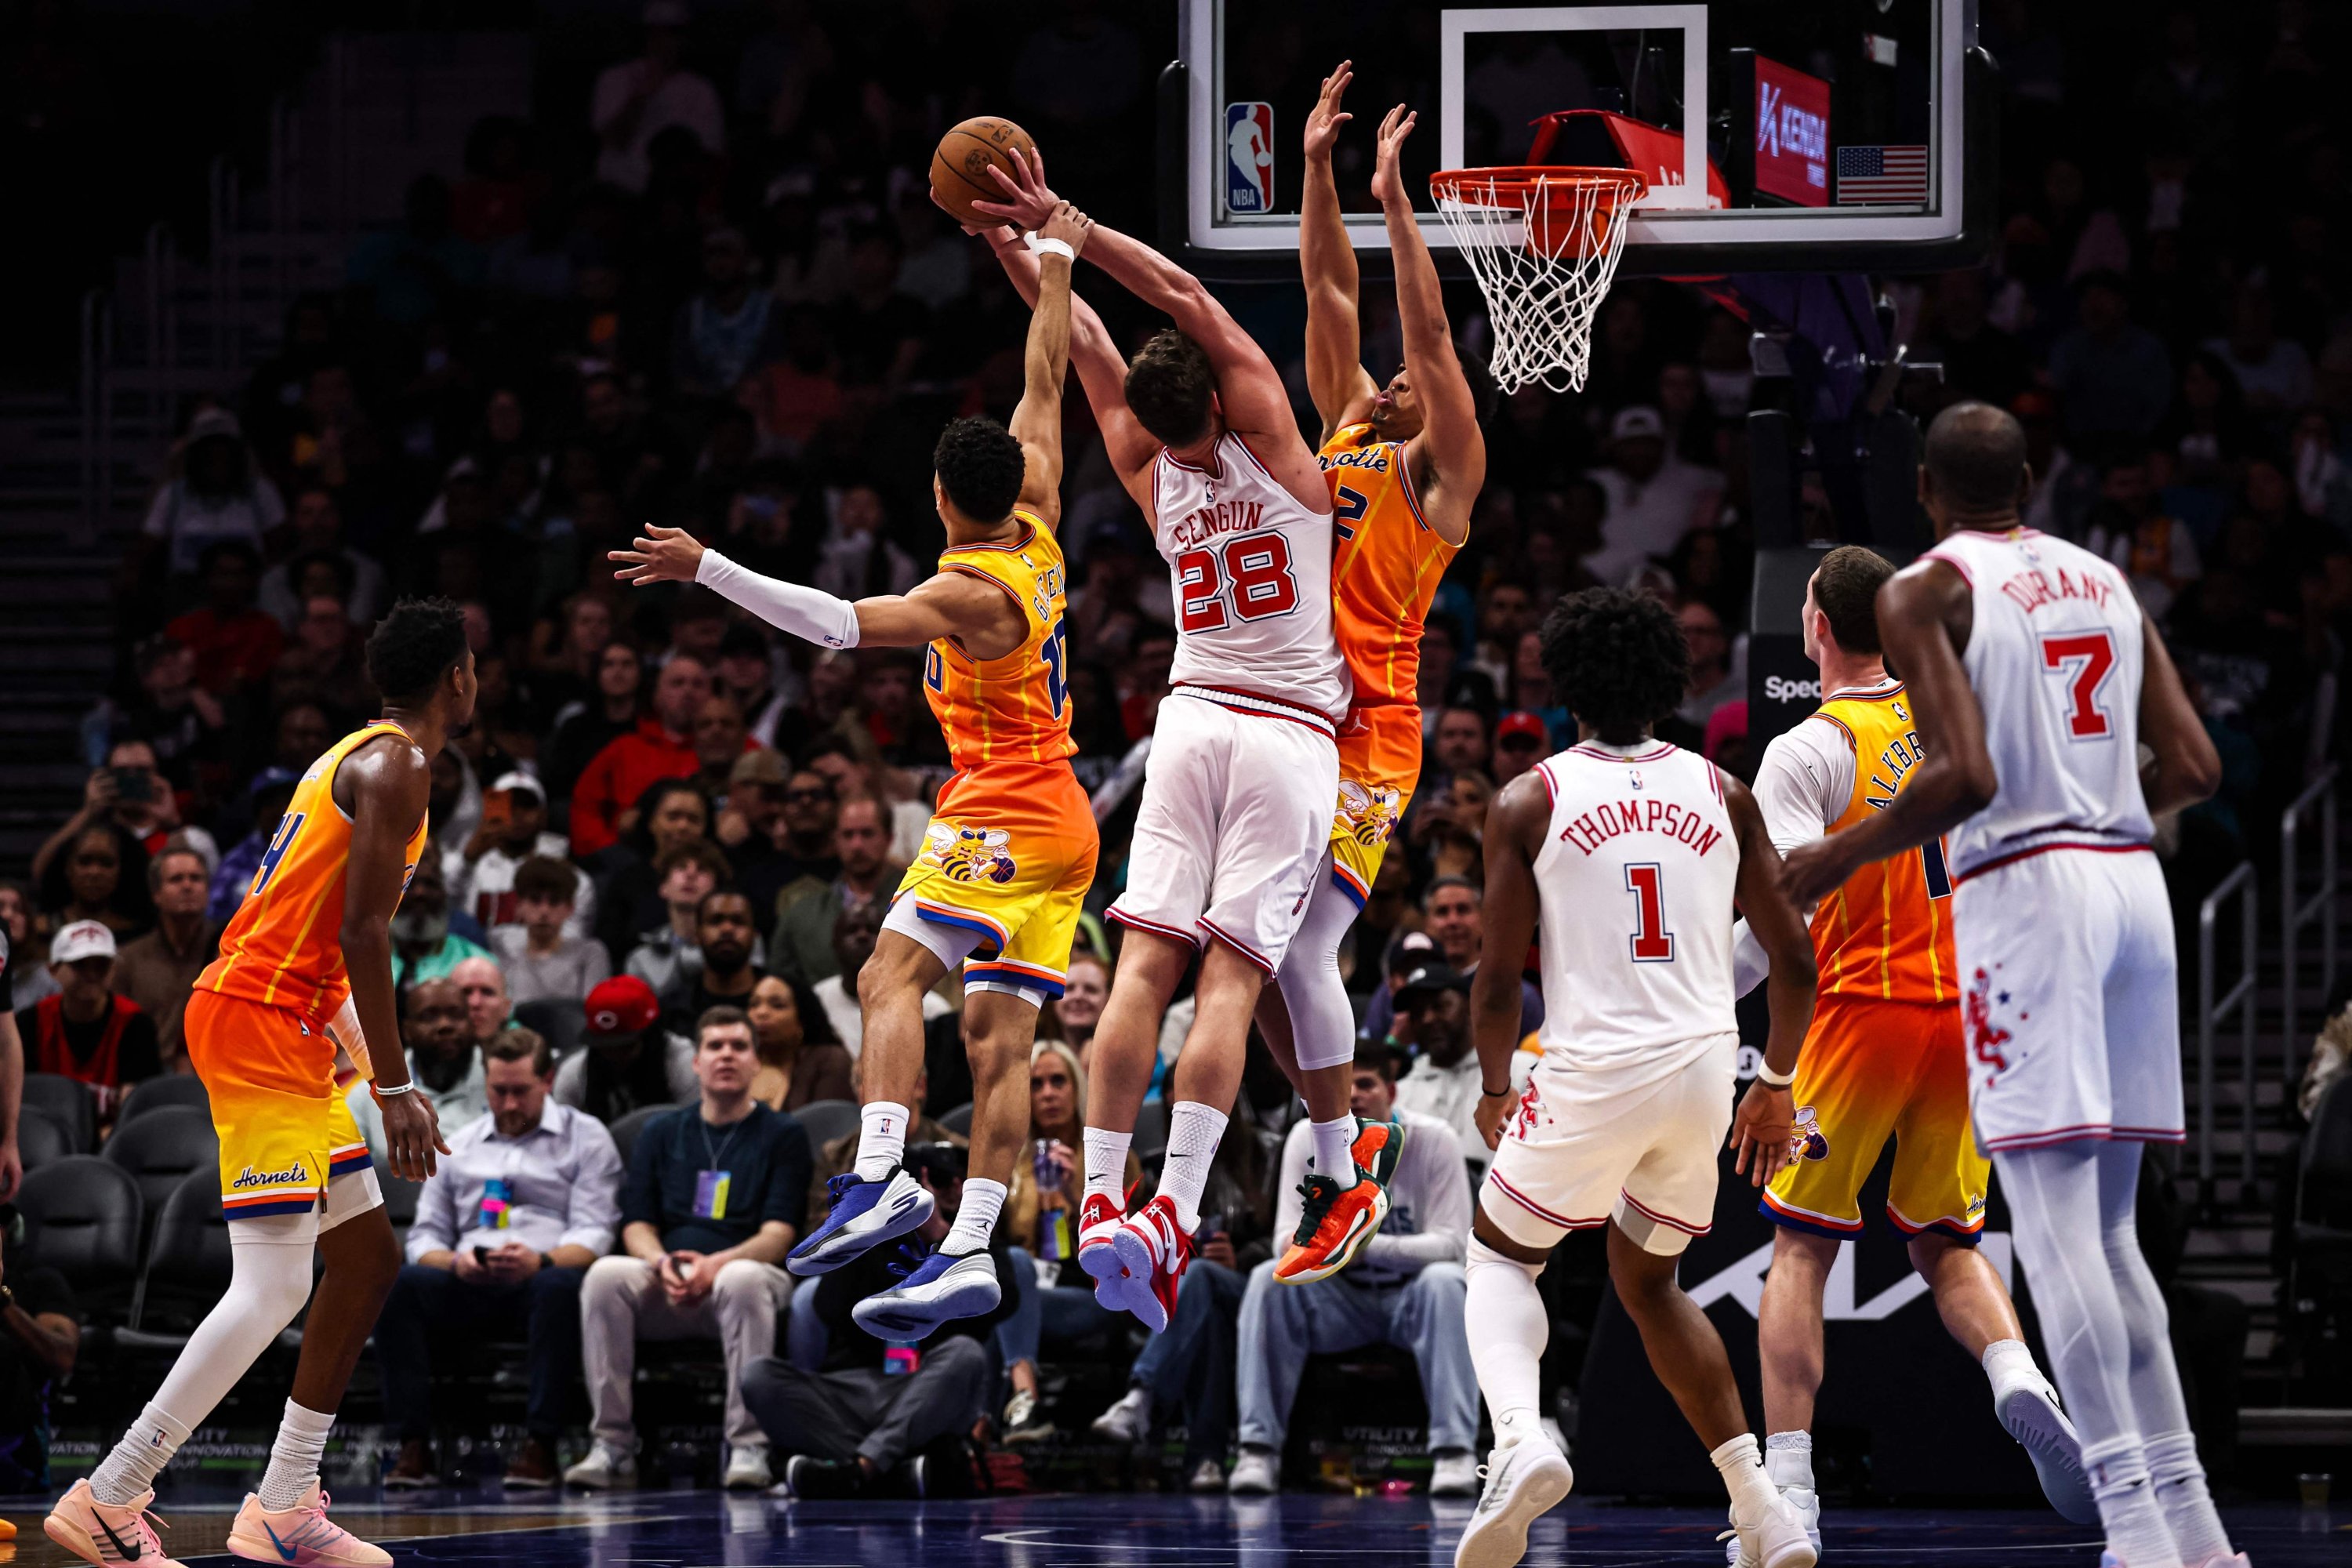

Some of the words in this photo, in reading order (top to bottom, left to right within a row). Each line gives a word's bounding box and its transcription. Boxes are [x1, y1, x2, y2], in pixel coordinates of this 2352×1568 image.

[1232, 188, 1256, 206] NBA
[1174, 500, 1265, 551] SENGUN
[1175, 529, 1301, 636] 28
[2035, 626, 2120, 743] 7
[253, 811, 307, 896] 4
[1559, 800, 1722, 857] THOMPSON
[1624, 862, 1675, 963] 1
[233, 1162, 309, 1189] Hornets
